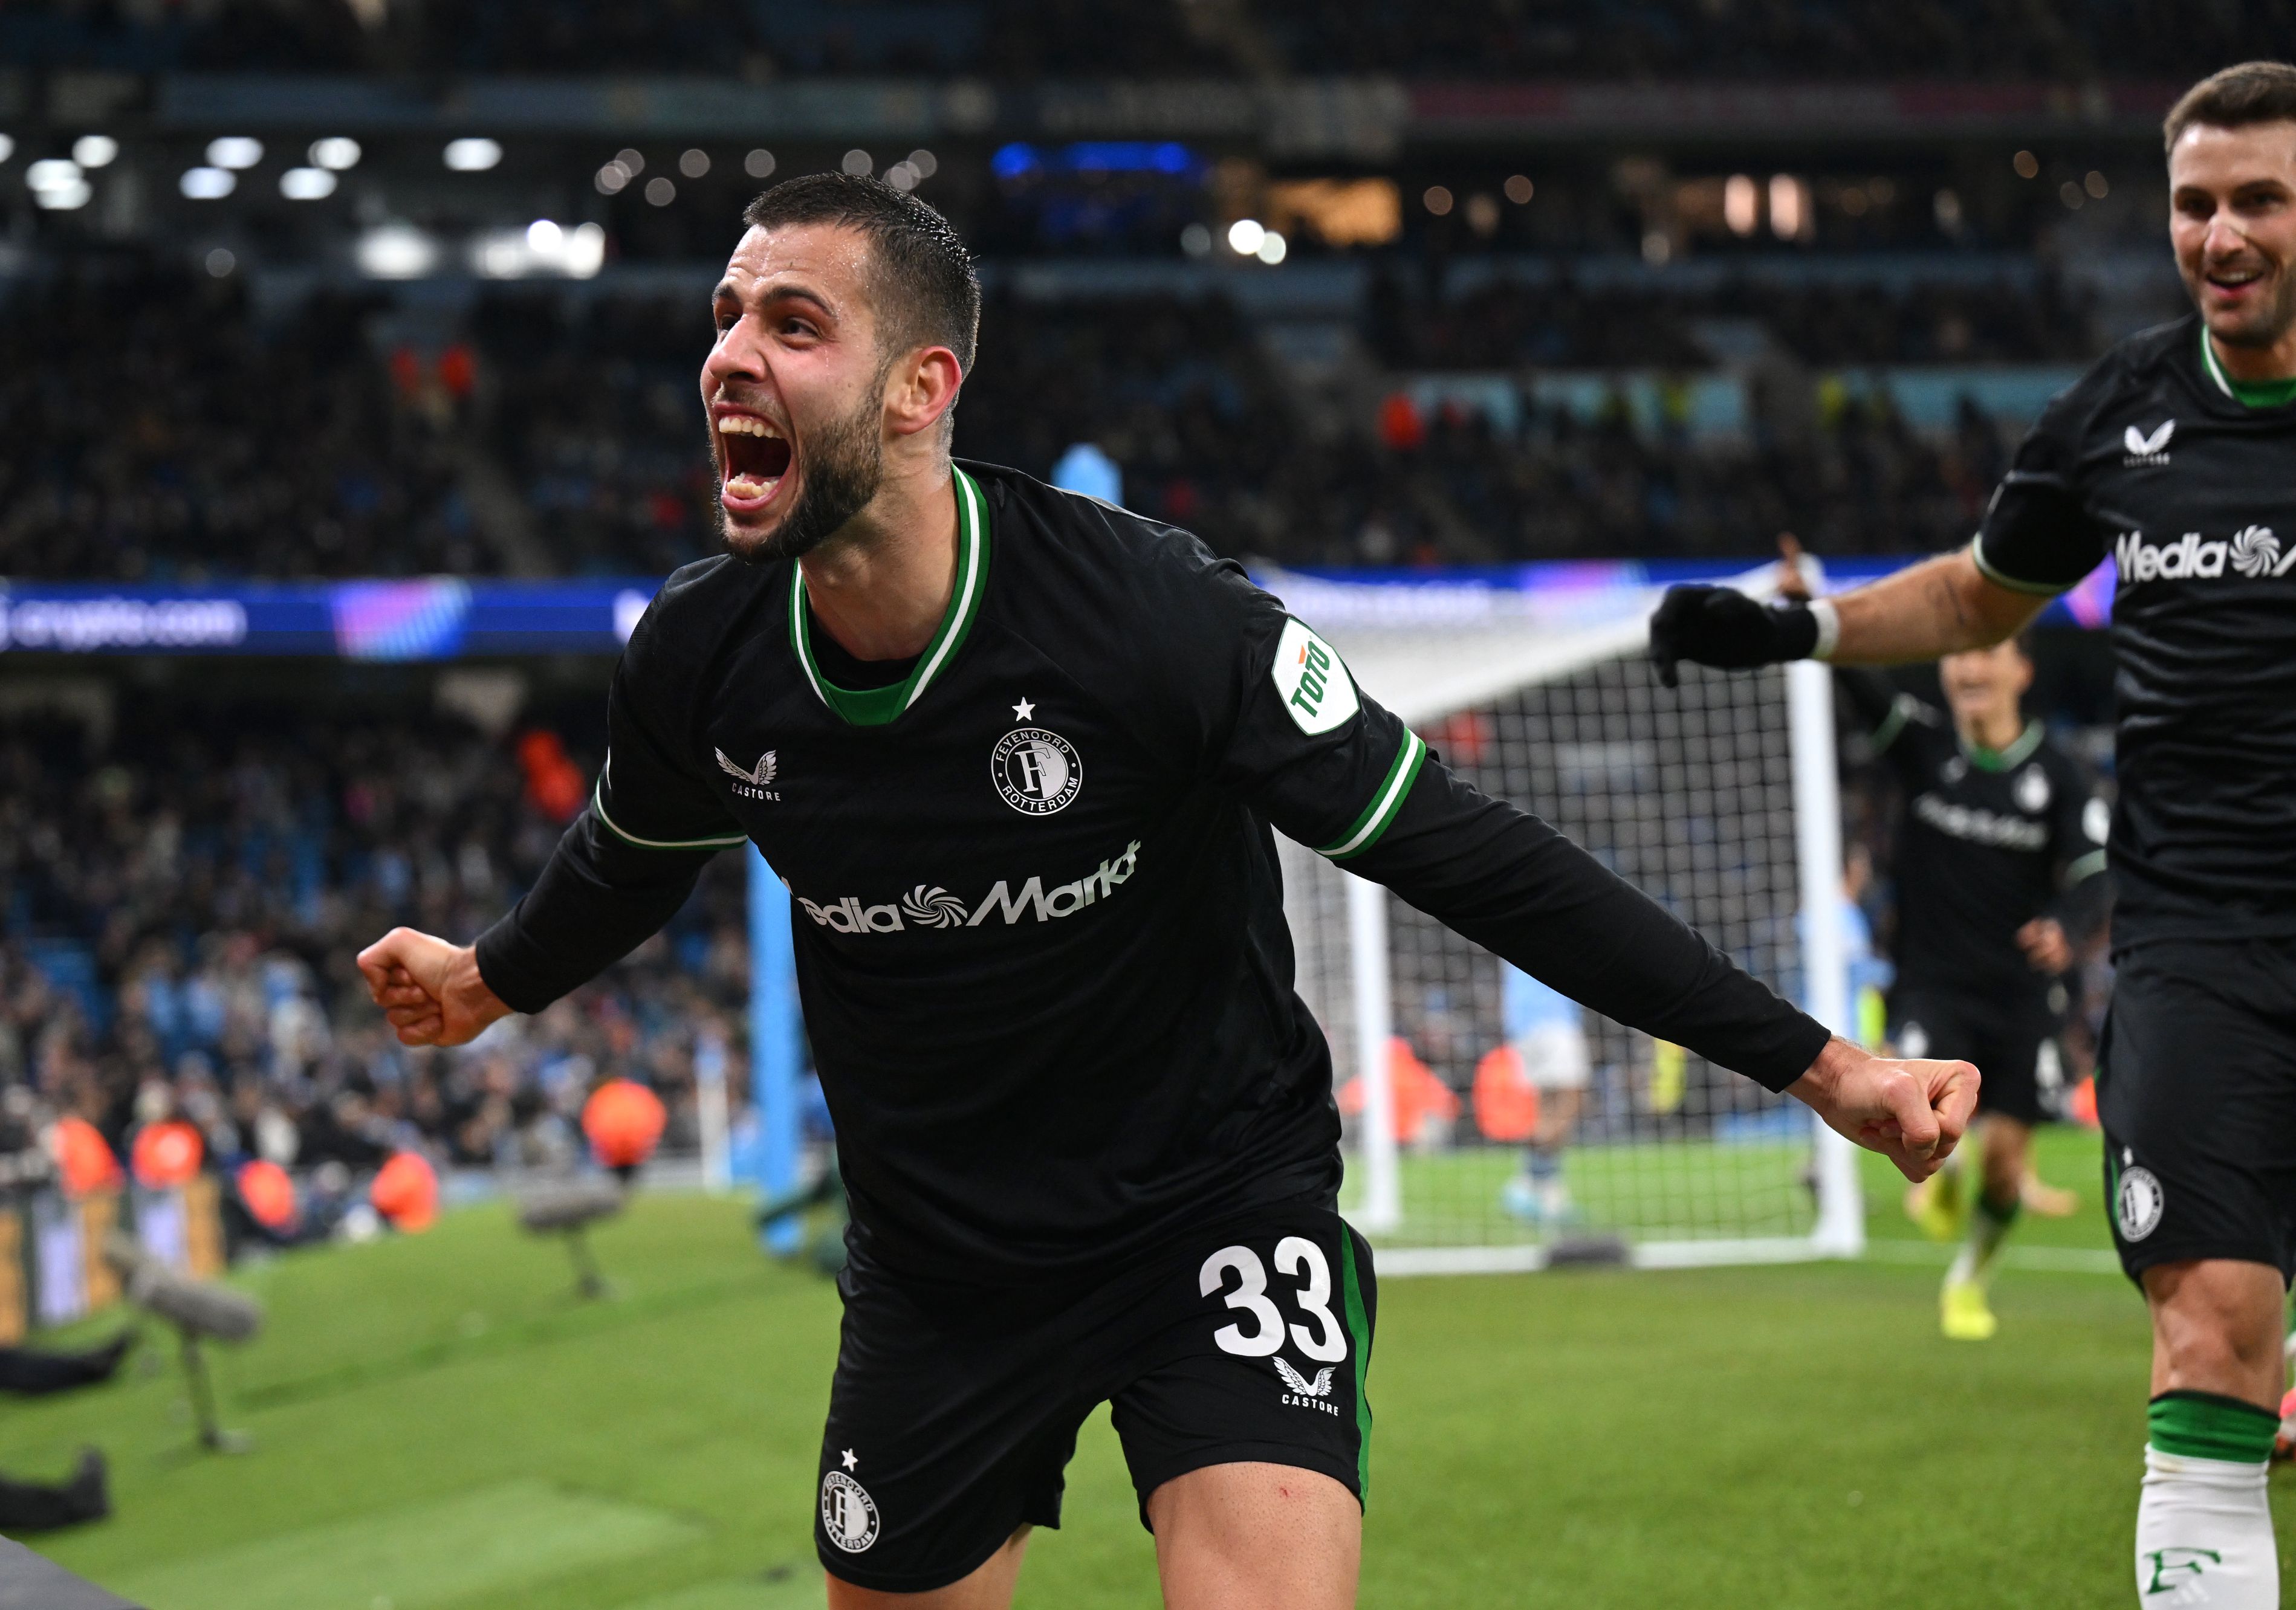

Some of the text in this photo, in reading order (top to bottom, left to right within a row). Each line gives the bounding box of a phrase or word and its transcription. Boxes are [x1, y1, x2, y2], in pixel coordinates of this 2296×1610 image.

[2116, 530, 2228, 583] Media
[1290, 641, 1330, 718] TOTO
[996, 731, 1069, 761] FEYENOORD
[732, 783, 780, 801] CASTORE
[1015, 747, 1051, 792] F
[1002, 777, 1078, 812] ROTTERDAM
[781, 839, 1141, 933] edia Markt
[1199, 1236, 1347, 1362] 33
[1282, 1394, 1338, 1417] CASTORE
[2144, 1547, 2221, 1594] F
